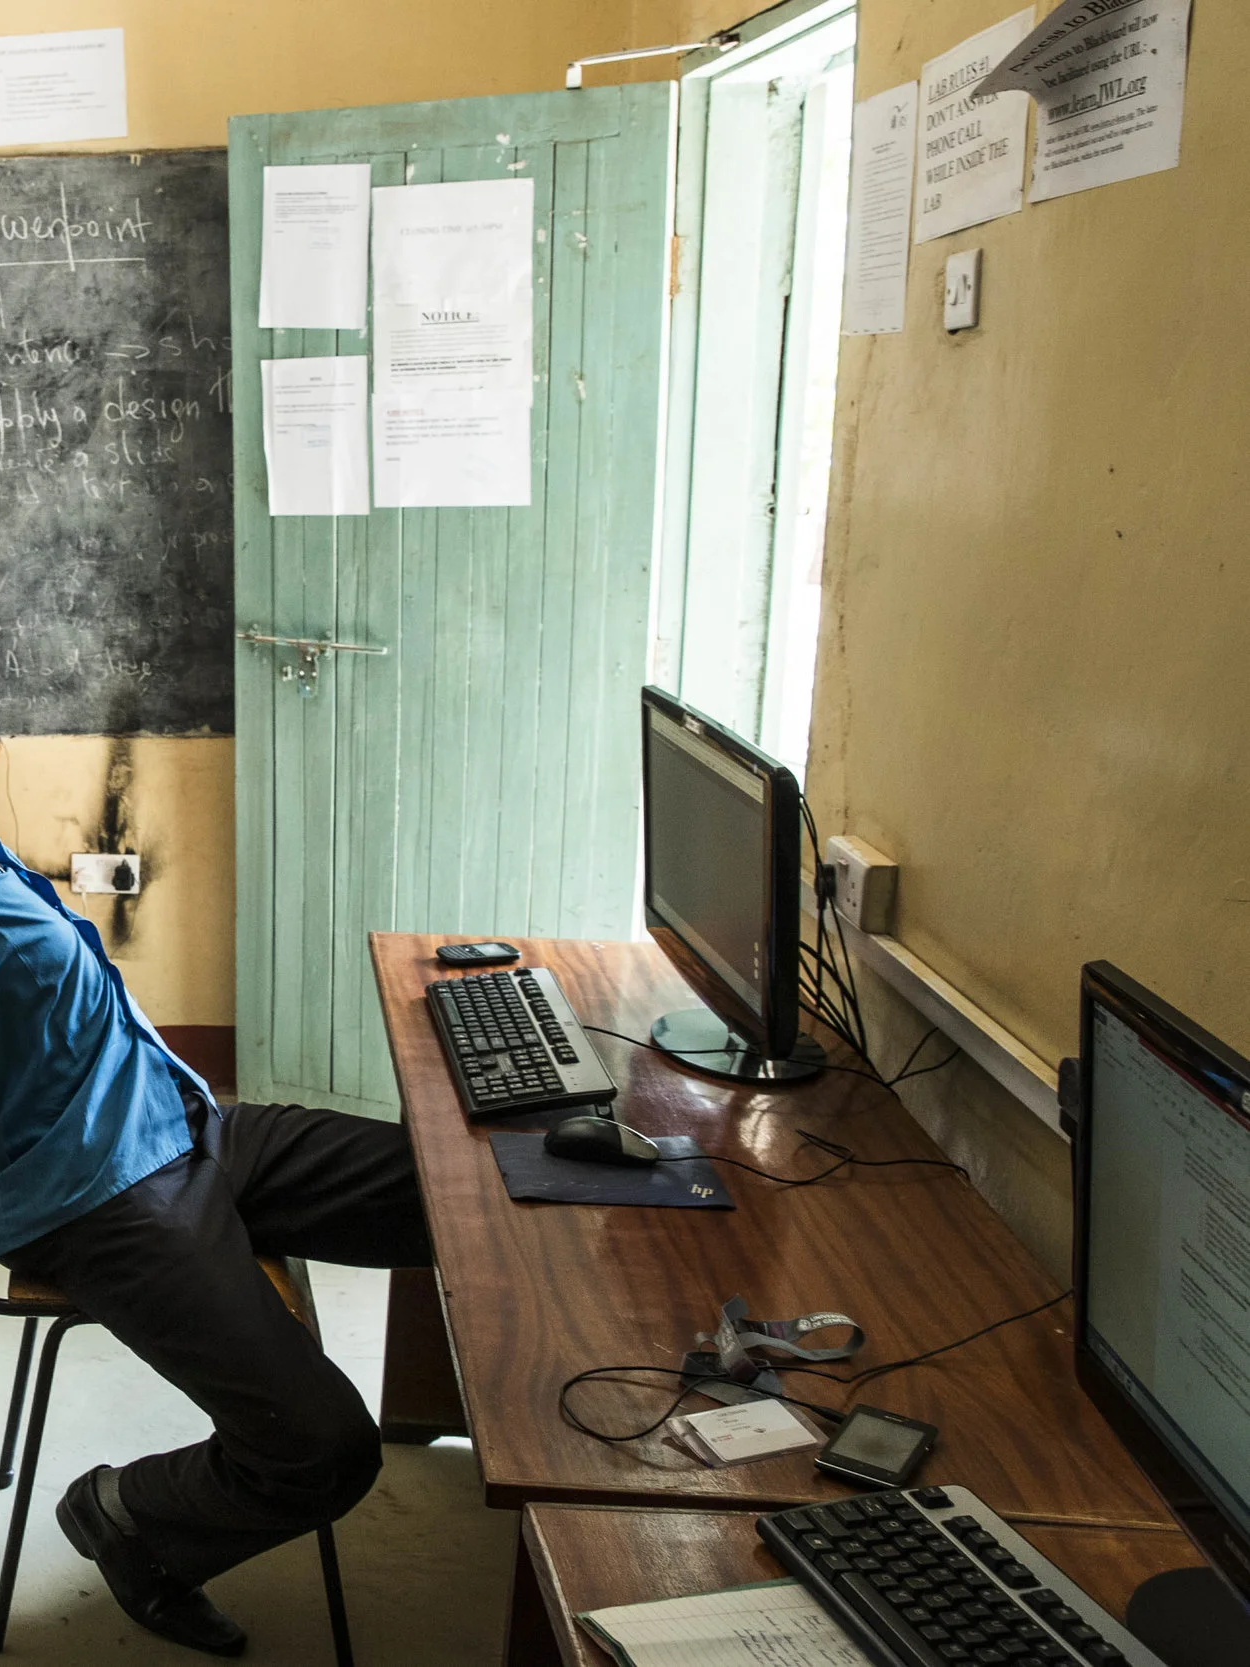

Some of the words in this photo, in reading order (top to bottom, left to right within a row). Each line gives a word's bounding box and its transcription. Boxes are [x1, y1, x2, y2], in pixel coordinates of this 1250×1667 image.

[1064, 15, 1087, 28] to
[928, 78, 948, 100] LAB
[949, 61, 978, 92] RULES
[925, 130, 956, 159] PHONE
[957, 119, 983, 146] CALL
[925, 160, 955, 185] WHILE
[956, 145, 987, 174] INSIDE
[987, 136, 1010, 161] THE
[923, 193, 943, 214] LAB
[73, 404, 88, 425] a
[104, 376, 201, 443] design
[691, 1184, 715, 1198] hp
